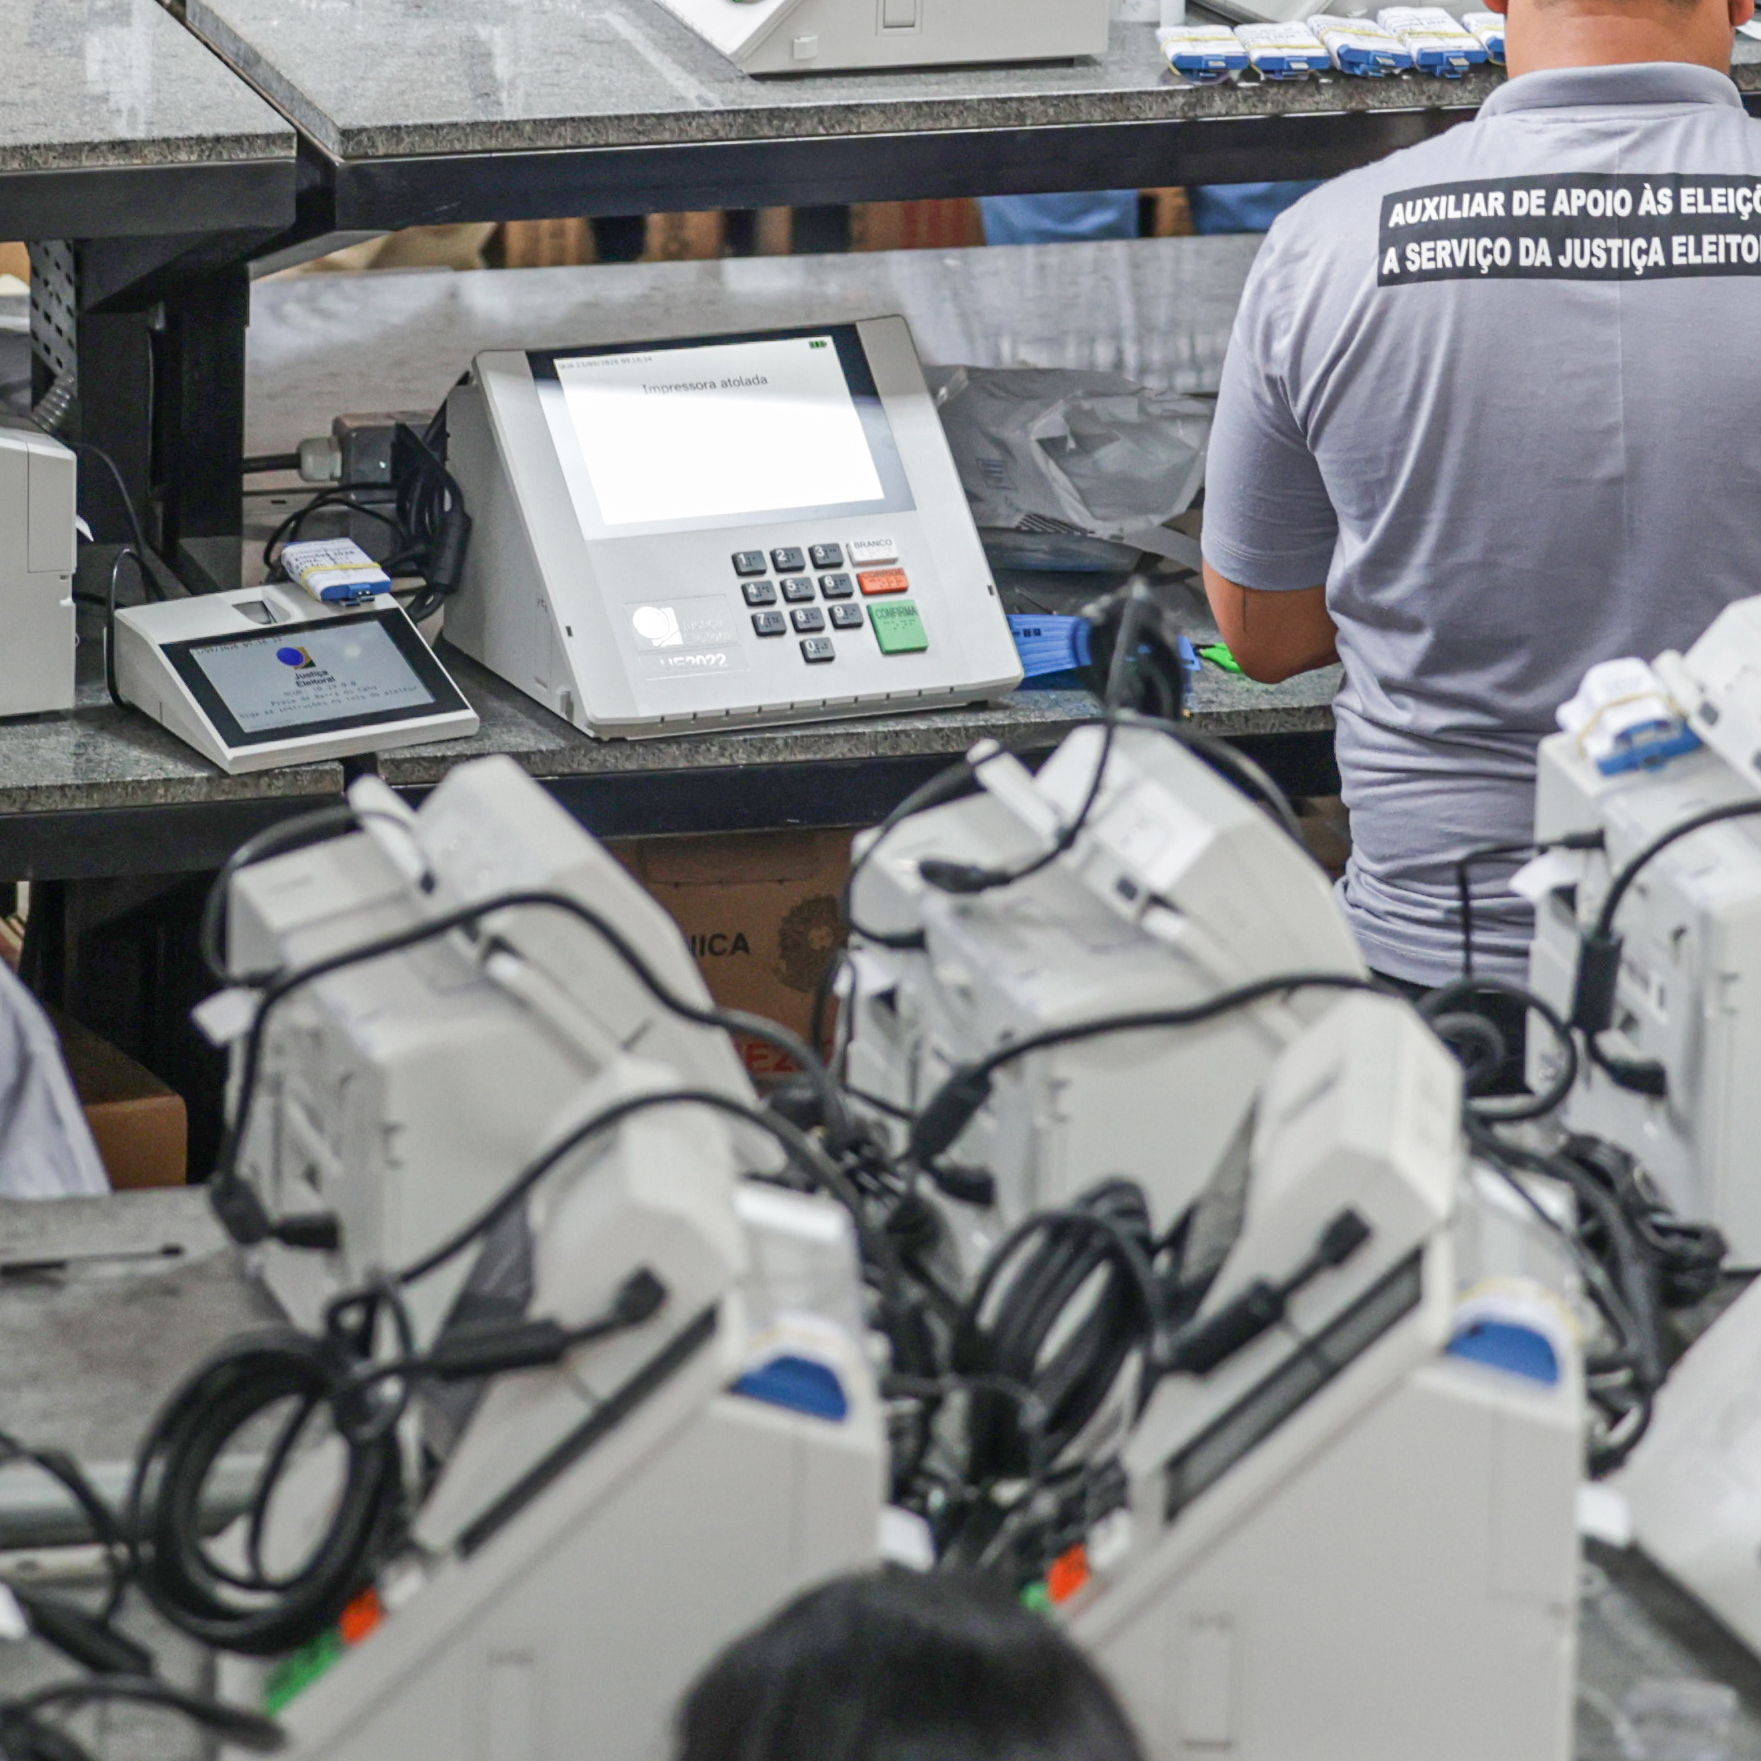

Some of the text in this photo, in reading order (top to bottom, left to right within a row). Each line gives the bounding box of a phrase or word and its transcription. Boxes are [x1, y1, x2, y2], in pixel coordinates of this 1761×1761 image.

[1388, 189, 1506, 228] AUXILIAR
[1512, 189, 1546, 217] DE
[1551, 187, 1632, 217] APOIO
[1638, 183, 1673, 216] ÀS
[1382, 246, 1400, 275] A
[1404, 236, 1511, 275] SERVIÇO
[1519, 236, 1553, 268] DA
[1557, 235, 1665, 275] JUSTIÇA
[641, 374, 768, 396] Impressora atolada
[853, 538, 893, 549] BRANCO
[776, 550, 786, 562] 2
[814, 545, 825, 558] 3
[739, 553, 747, 565] 1
[787, 579, 796, 591] 5
[824, 576, 834, 588] 6
[747, 583, 758, 595] 4
[796, 610, 806, 622] 8
[834, 606, 844, 618] 9
[874, 604, 919, 619] CONFIRMA
[756, 614, 766, 626] 7
[805, 640, 816, 652] 0
